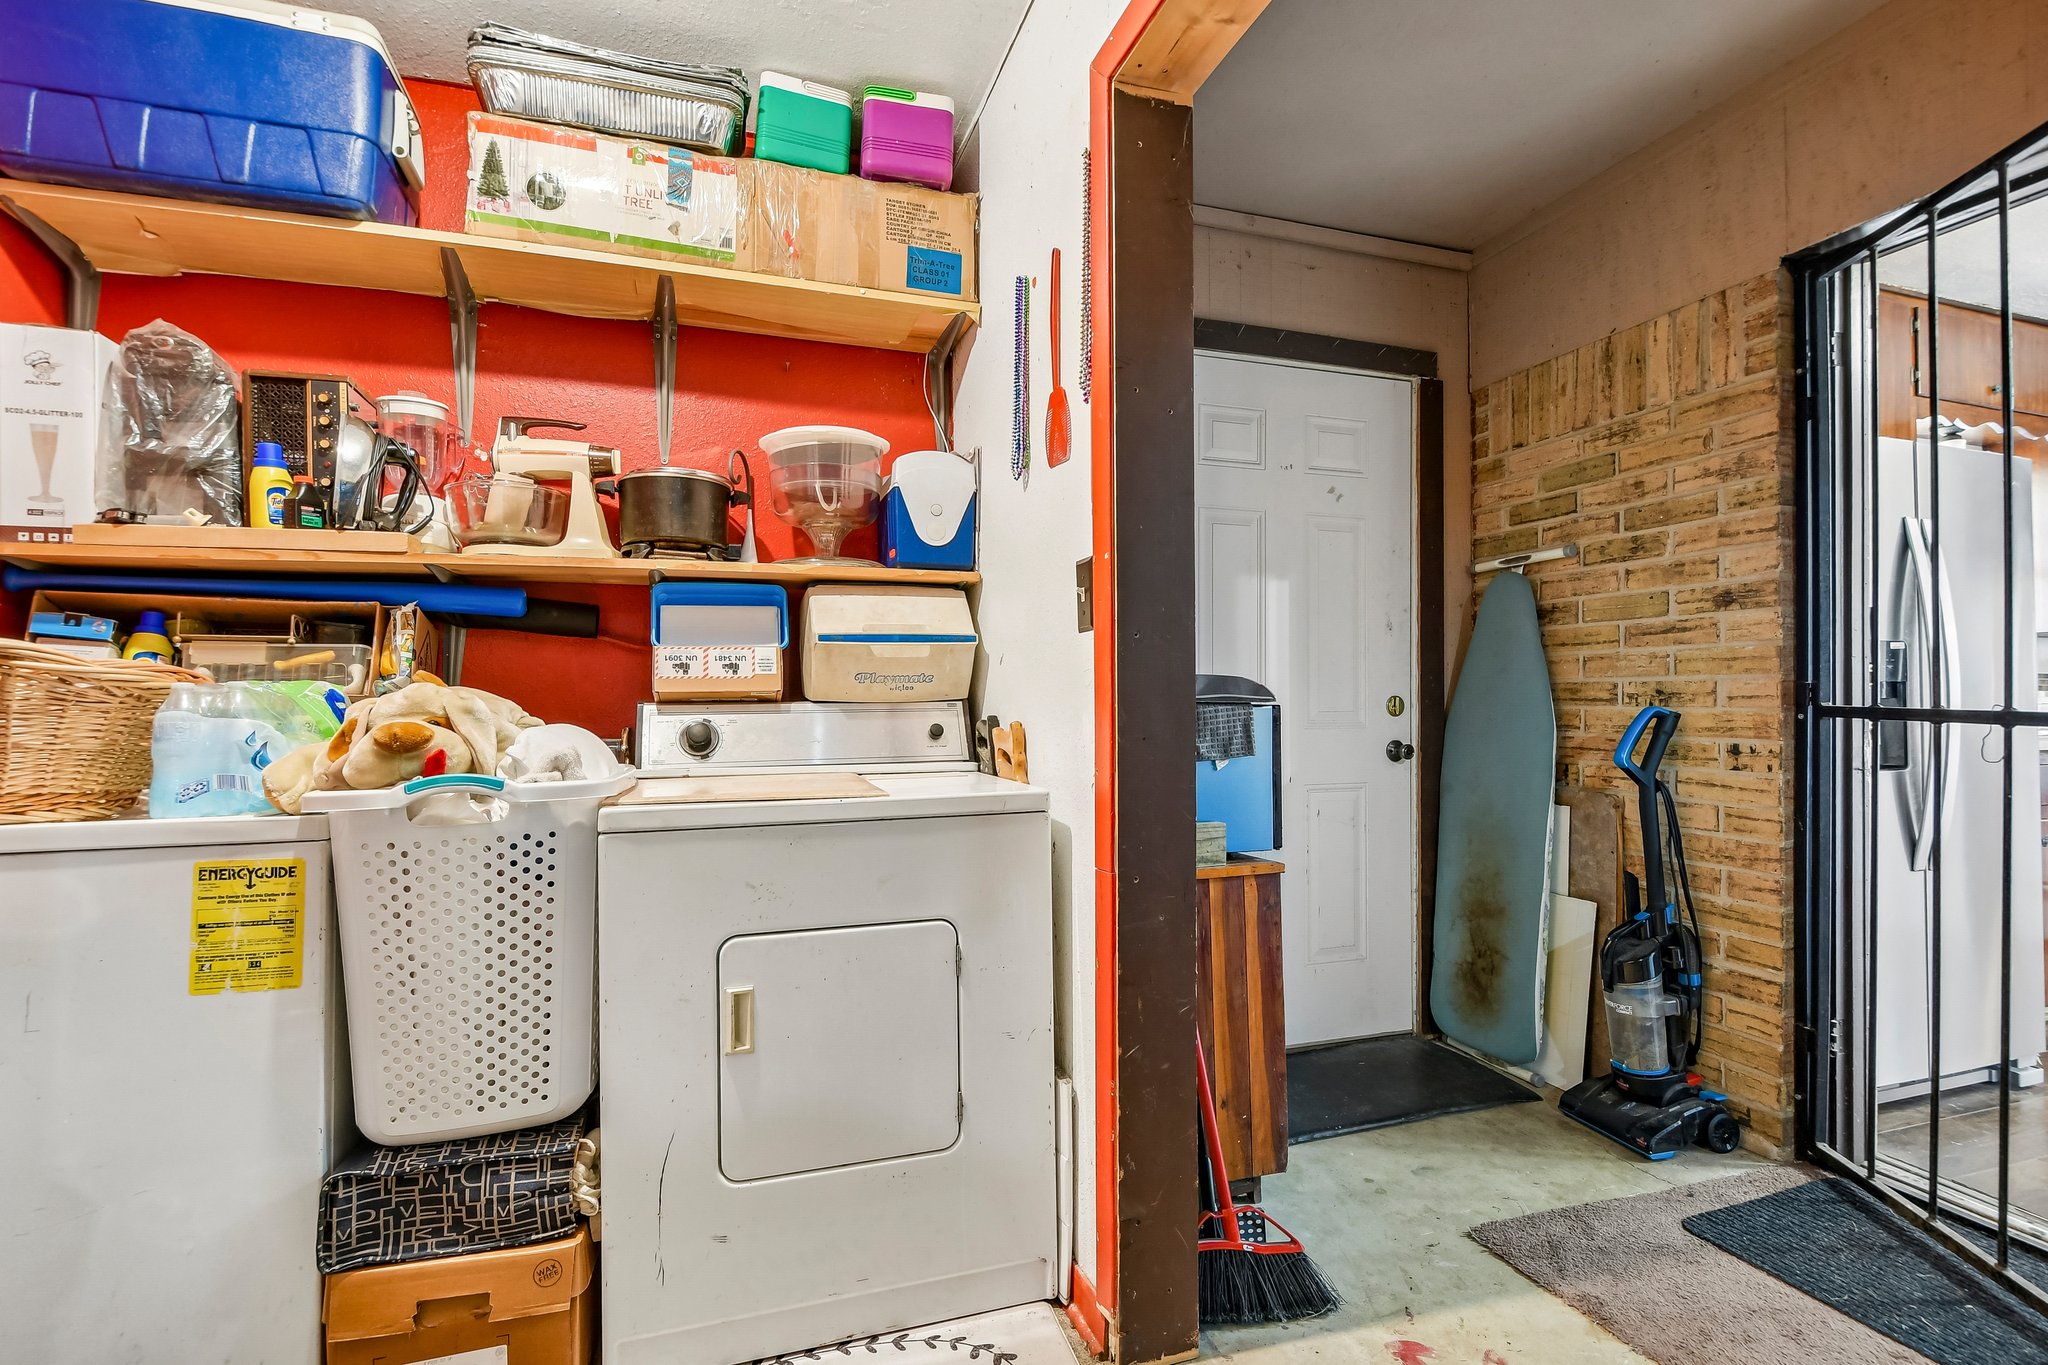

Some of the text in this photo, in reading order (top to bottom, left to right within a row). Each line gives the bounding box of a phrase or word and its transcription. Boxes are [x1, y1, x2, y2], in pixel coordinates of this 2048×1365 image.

[636, 186, 662, 200] UNLI
[624, 196, 653, 210] TREE
[886, 198, 905, 206] TARGET
[910, 256, 956, 270] Trim-A-Tree
[912, 266, 939, 276] CLASS
[912, 276, 942, 286] GROUP
[854, 672, 935, 686] Playmate
[895, 684, 914, 692] igloo
[198, 866, 298, 884] ENERGYGUIDE
[536, 1263, 558, 1276] WAX
[539, 1269, 560, 1283] FREE
